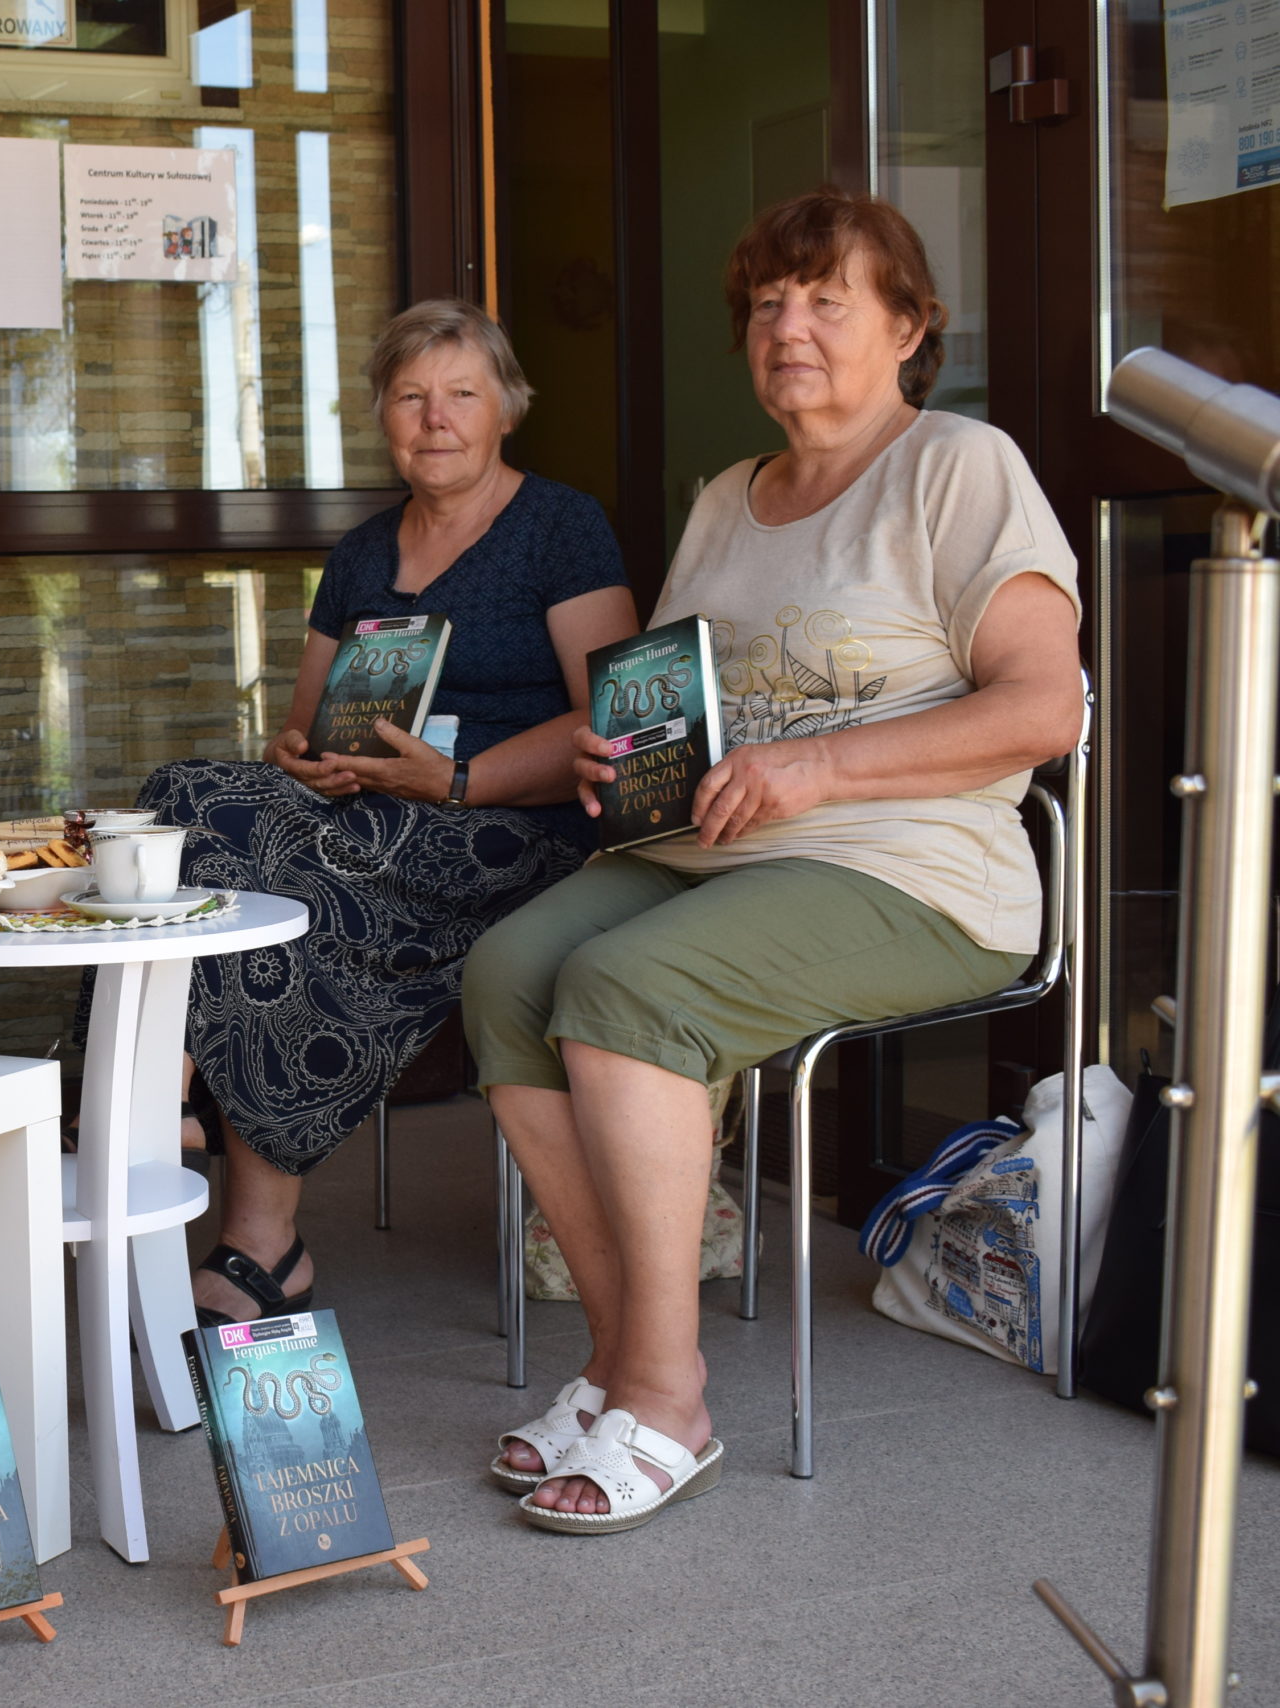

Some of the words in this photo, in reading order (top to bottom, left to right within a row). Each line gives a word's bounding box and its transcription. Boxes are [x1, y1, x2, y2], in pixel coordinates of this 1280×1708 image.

[88, 168, 124, 178] Centrum
[125, 170, 155, 180] Kultury
[608, 655, 644, 674] Fergus
[646, 641, 678, 663] Hume
[619, 741, 695, 777] AJEMNICA
[619, 763, 687, 796] BROSZKI
[621, 797, 631, 815] Z
[634, 781, 688, 811] OPALU
[233, 1343, 278, 1360] Fergus
[280, 1337, 318, 1352] Hume
[253, 1455, 360, 1492] TAJEMNICA
[270, 1480, 355, 1514] BROSZKI
[278, 1516, 291, 1537] Z
[294, 1502, 358, 1533] OPALU
